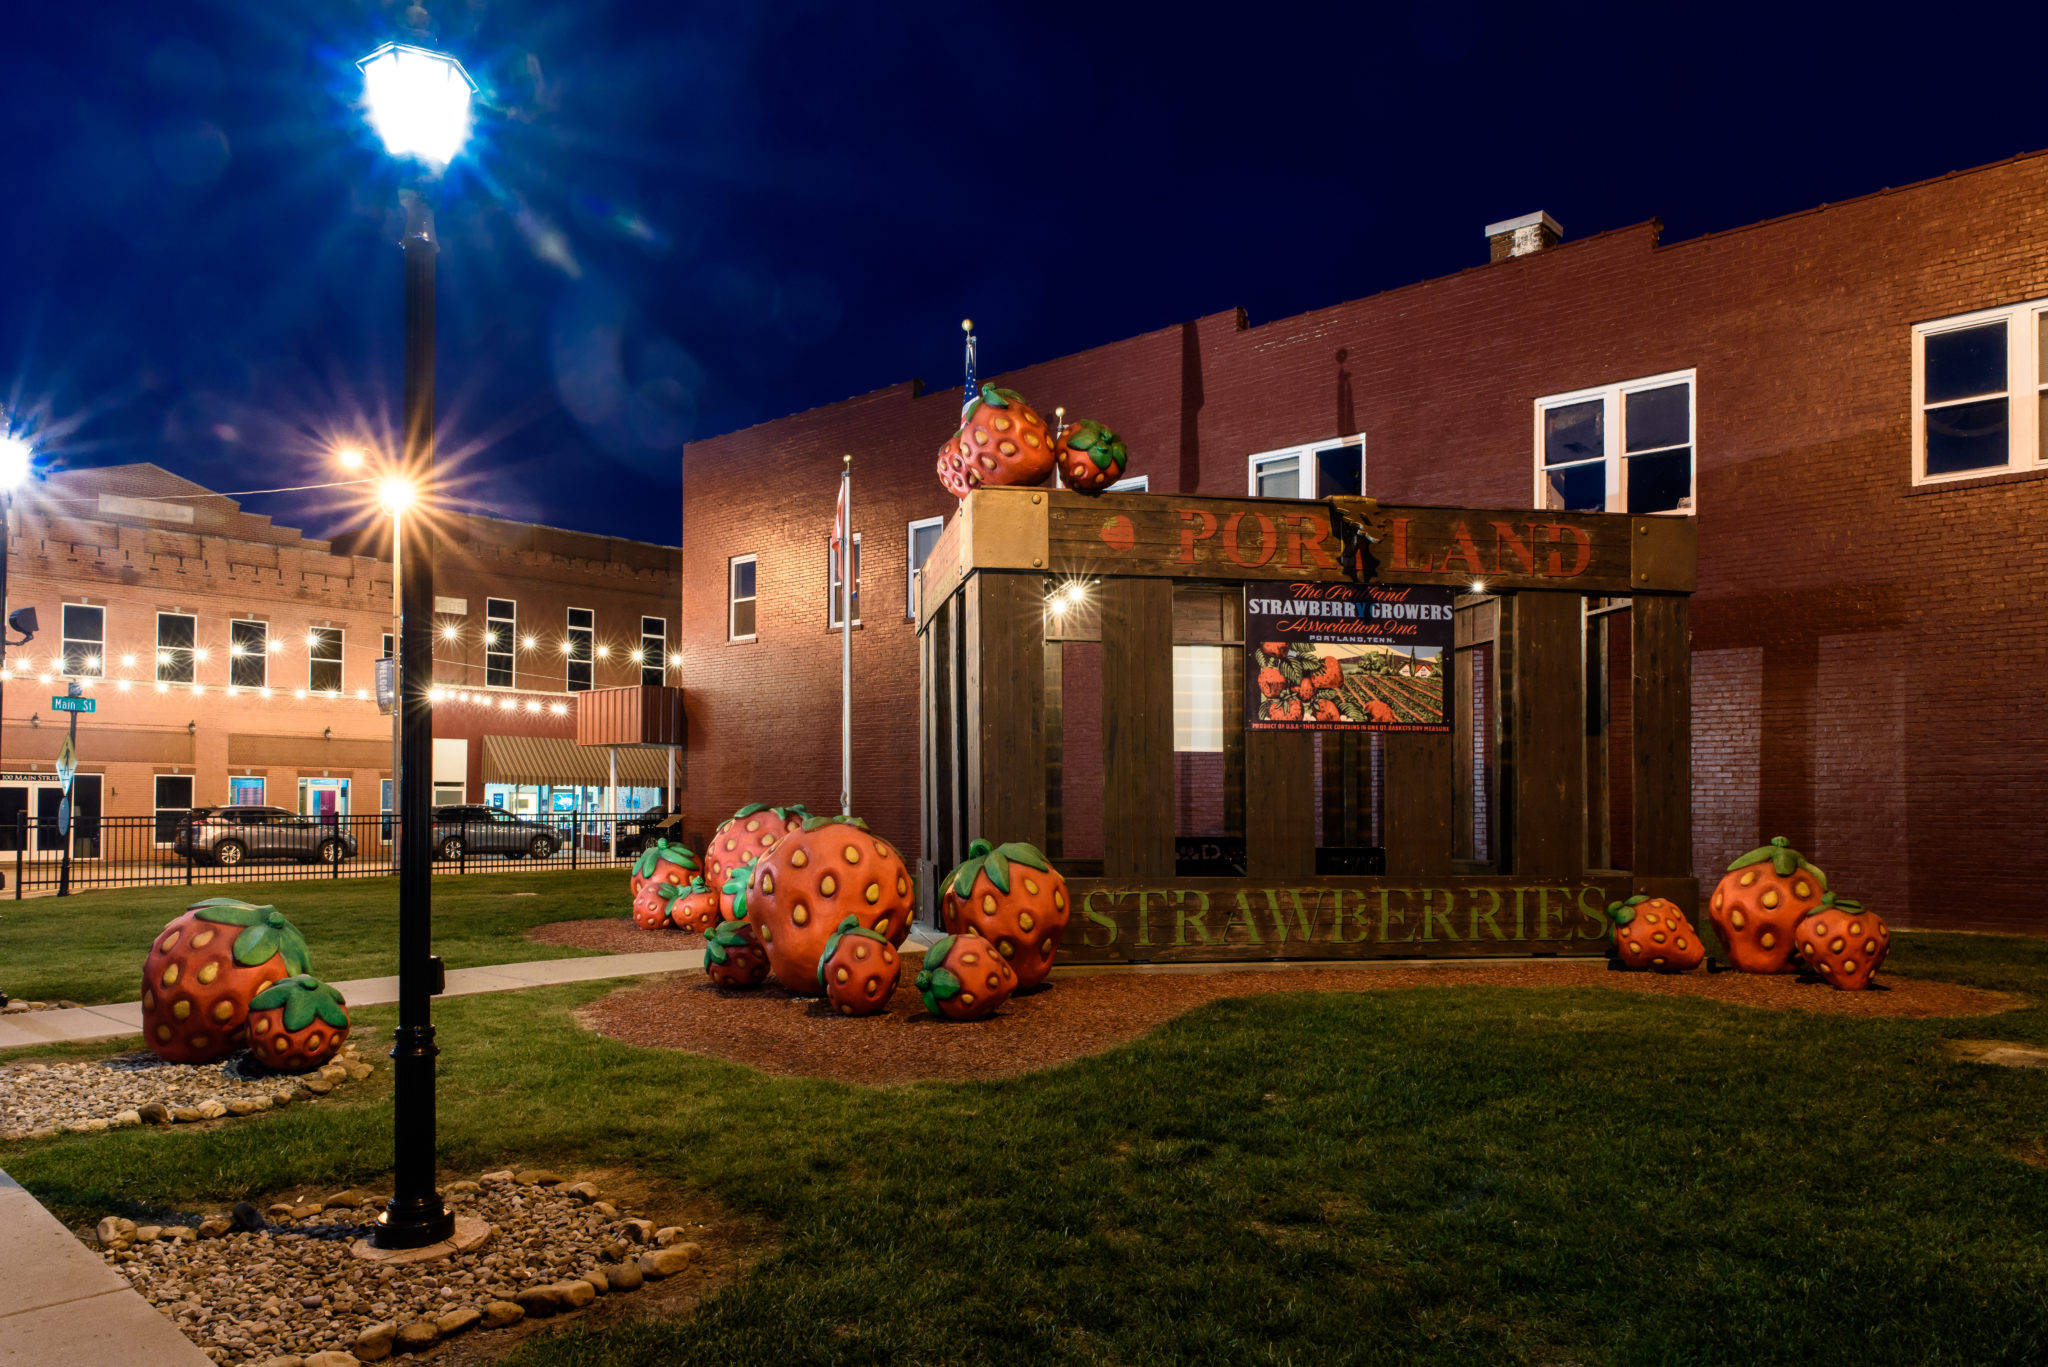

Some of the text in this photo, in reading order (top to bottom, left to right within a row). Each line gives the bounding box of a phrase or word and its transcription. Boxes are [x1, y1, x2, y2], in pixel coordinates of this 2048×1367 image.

[1174, 508, 1591, 578] PORLAND
[1289, 583, 1323, 599] The
[1249, 599, 1453, 620] STRAWBERRY GROWERS
[55, 698, 92, 711] Main St
[1083, 886, 1608, 948] STRAWBERRIES
